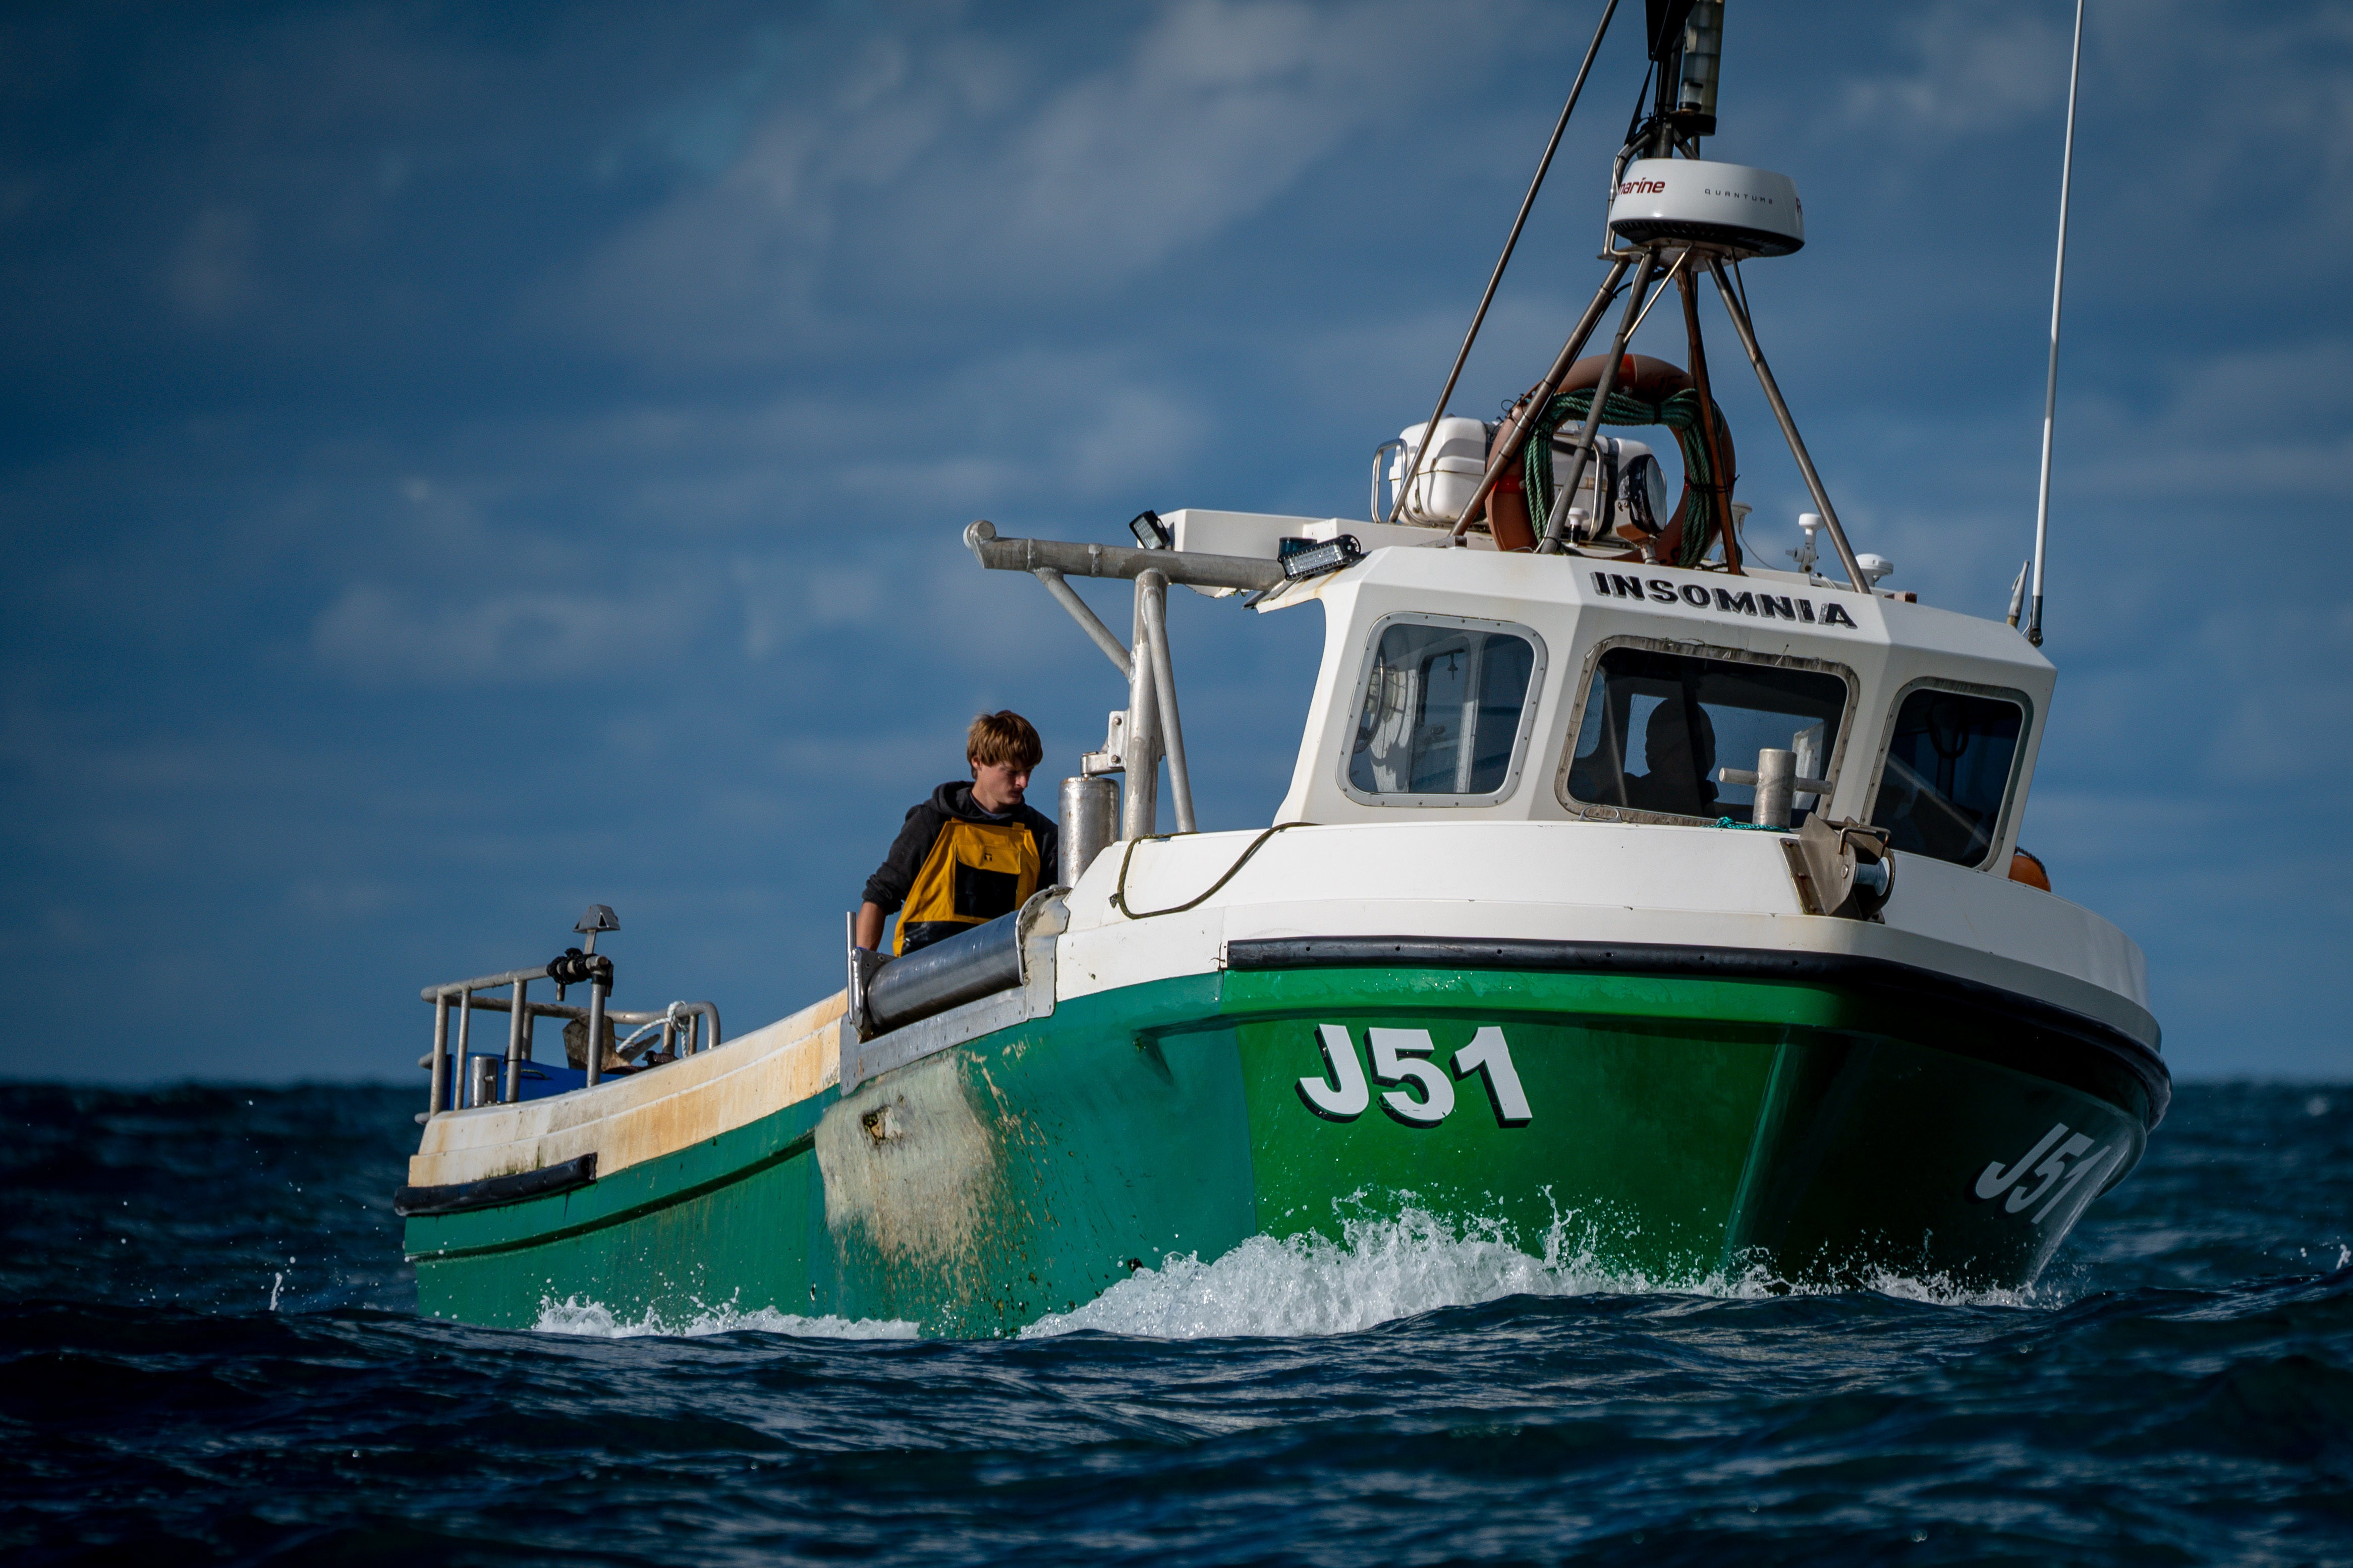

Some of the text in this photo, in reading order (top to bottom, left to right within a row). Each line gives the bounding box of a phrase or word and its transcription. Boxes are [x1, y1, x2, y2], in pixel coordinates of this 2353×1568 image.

[1589, 571, 1858, 629] INSOMNIA
[1295, 1023, 1533, 1128] J51
[1975, 1122, 2112, 1225] J51
